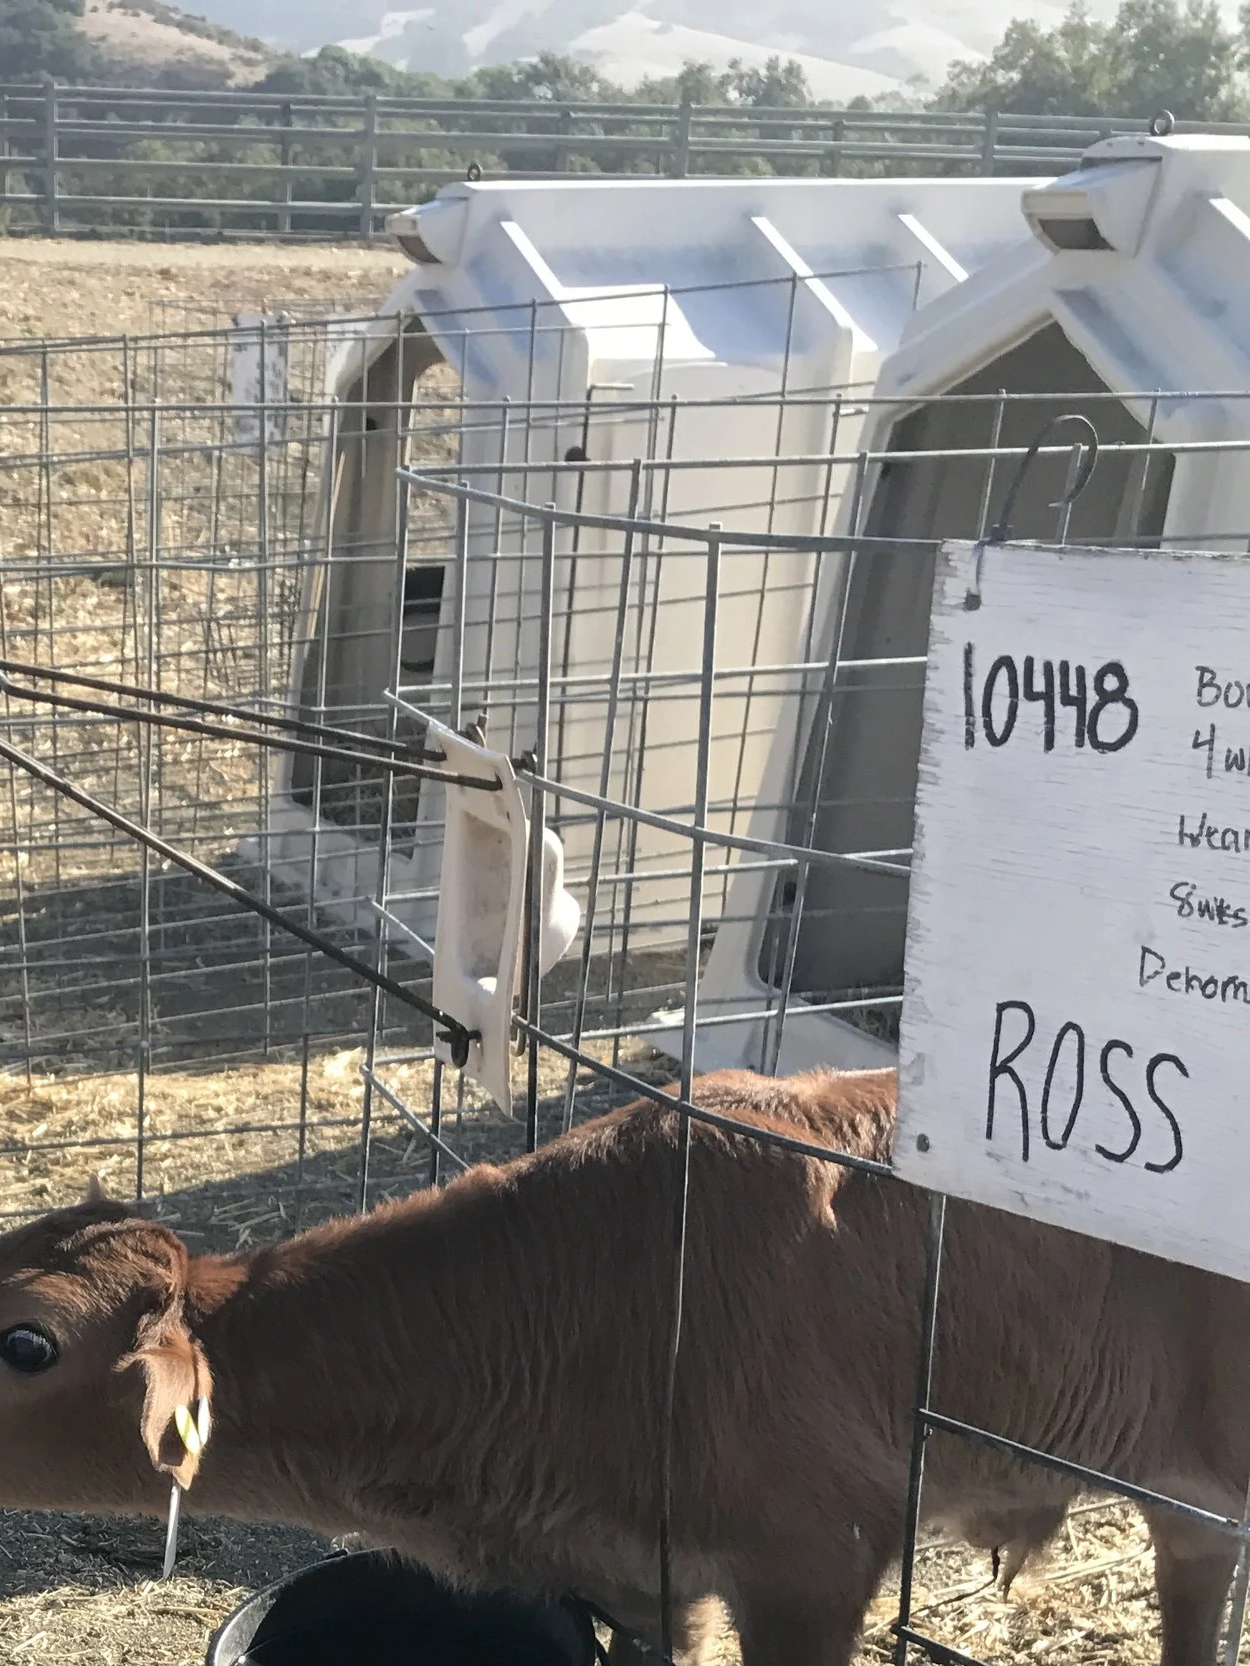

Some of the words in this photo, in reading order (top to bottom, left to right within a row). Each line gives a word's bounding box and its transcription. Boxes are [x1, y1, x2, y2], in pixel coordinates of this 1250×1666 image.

[963, 642, 1139, 754] 10448
[1225, 747, 1250, 776] w
[986, 1000, 1190, 1174] ROSS
